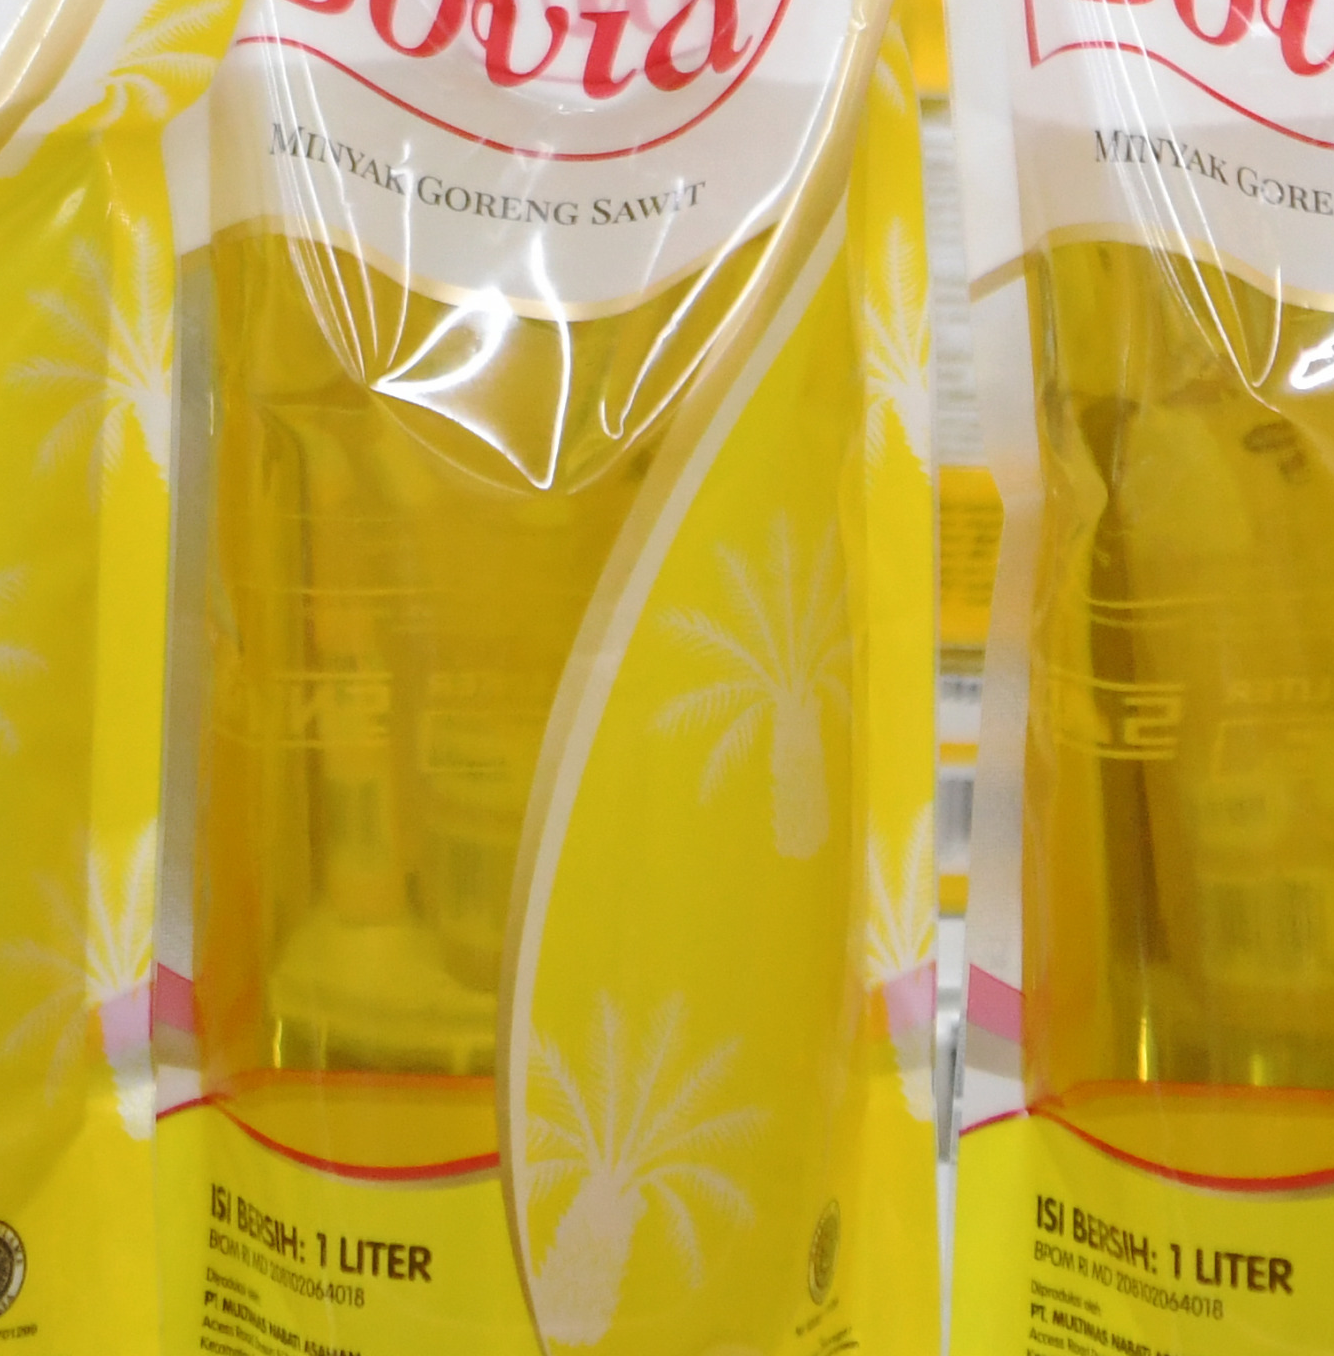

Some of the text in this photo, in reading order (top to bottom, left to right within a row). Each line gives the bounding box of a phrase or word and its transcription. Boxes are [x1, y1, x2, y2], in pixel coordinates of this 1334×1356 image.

[270, 122, 707, 226] MINYAK GORENG SAWIT
[1094, 129, 1230, 186] MINYAK
[211, 1182, 433, 1283] ISI BERSIH: 1 LITER
[1033, 1239, 1075, 1272] BPOM
[1091, 1260, 1113, 1287] MD
[1036, 1194, 1294, 1295] ISI BERSIH: 1 LITER
